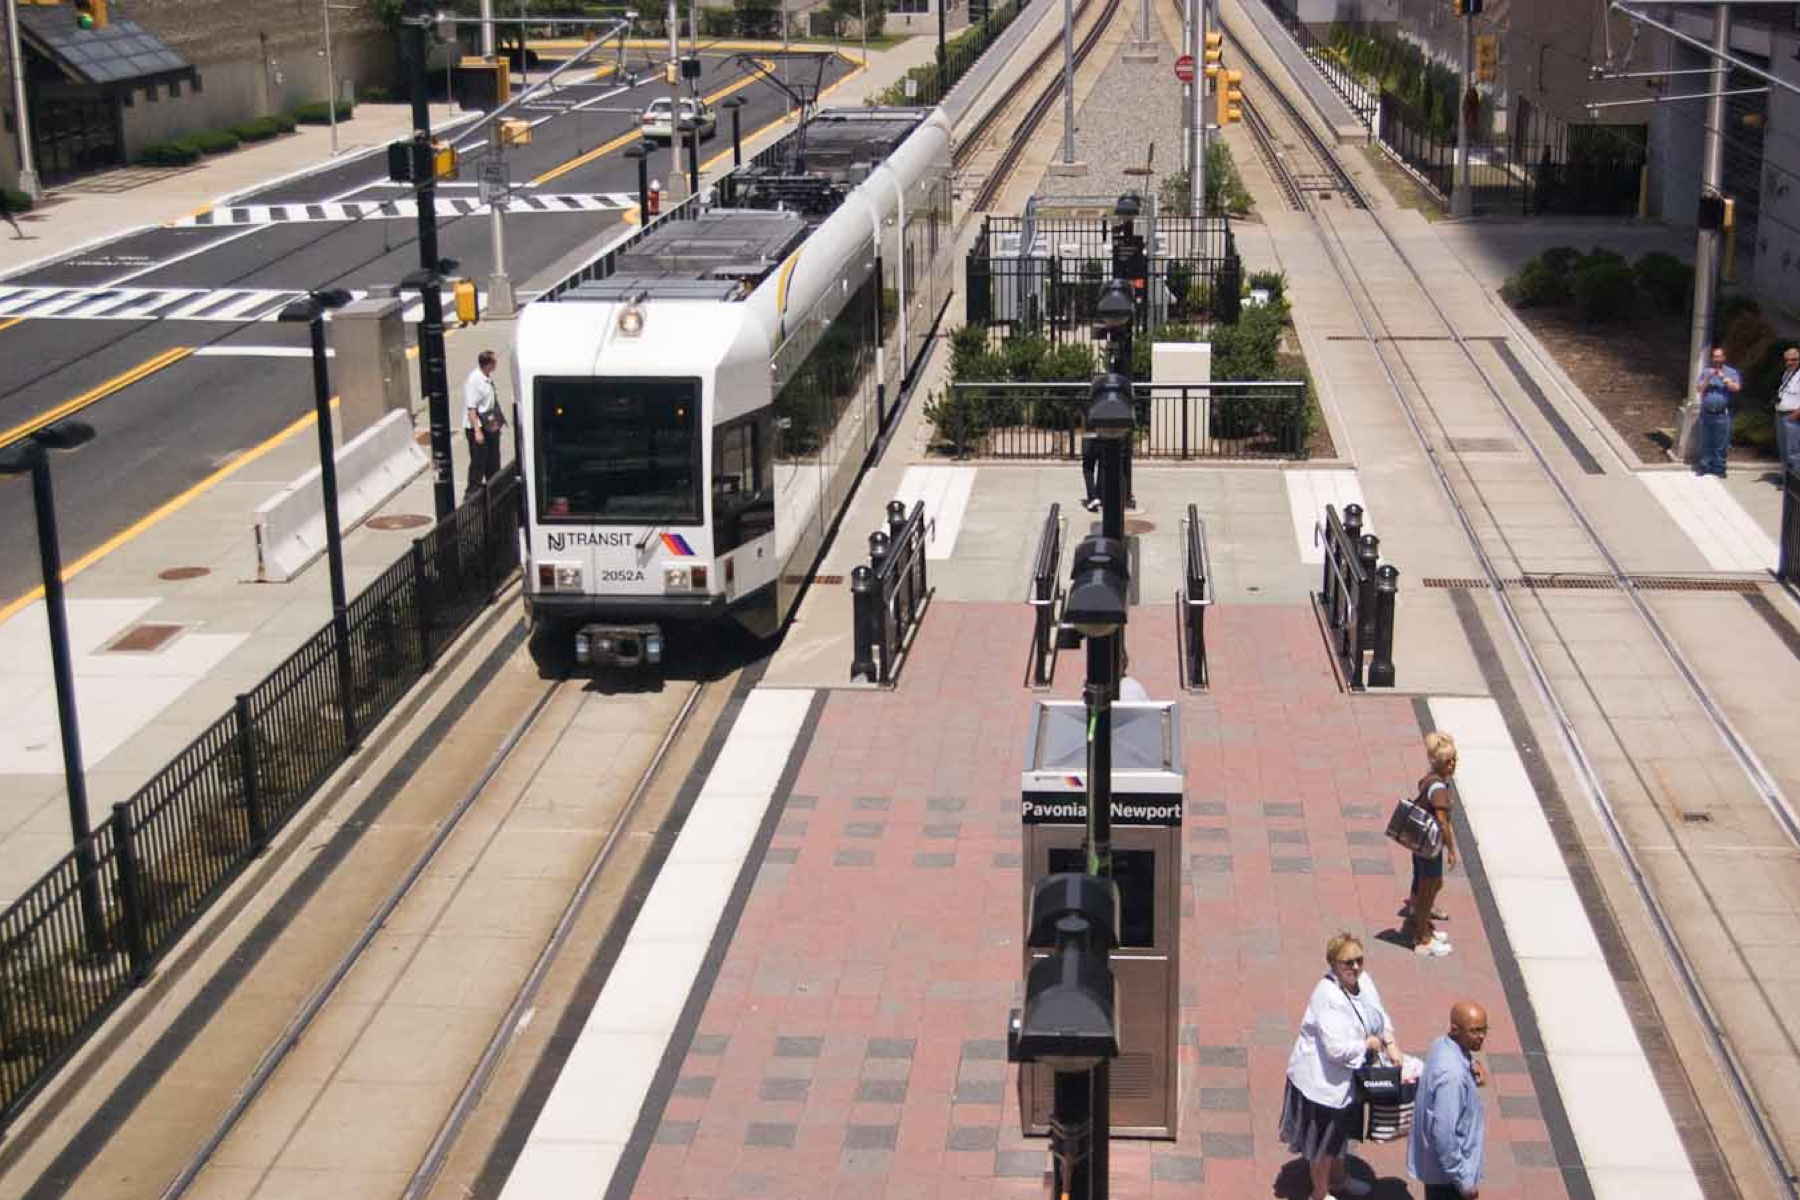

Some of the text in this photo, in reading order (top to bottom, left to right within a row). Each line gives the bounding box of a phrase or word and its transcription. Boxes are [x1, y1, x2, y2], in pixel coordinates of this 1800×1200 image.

[548, 532, 633, 551] NJ TRANSIT
[601, 571, 645, 582] 2052A
[1022, 801, 1182, 820] Pavonia Newport
